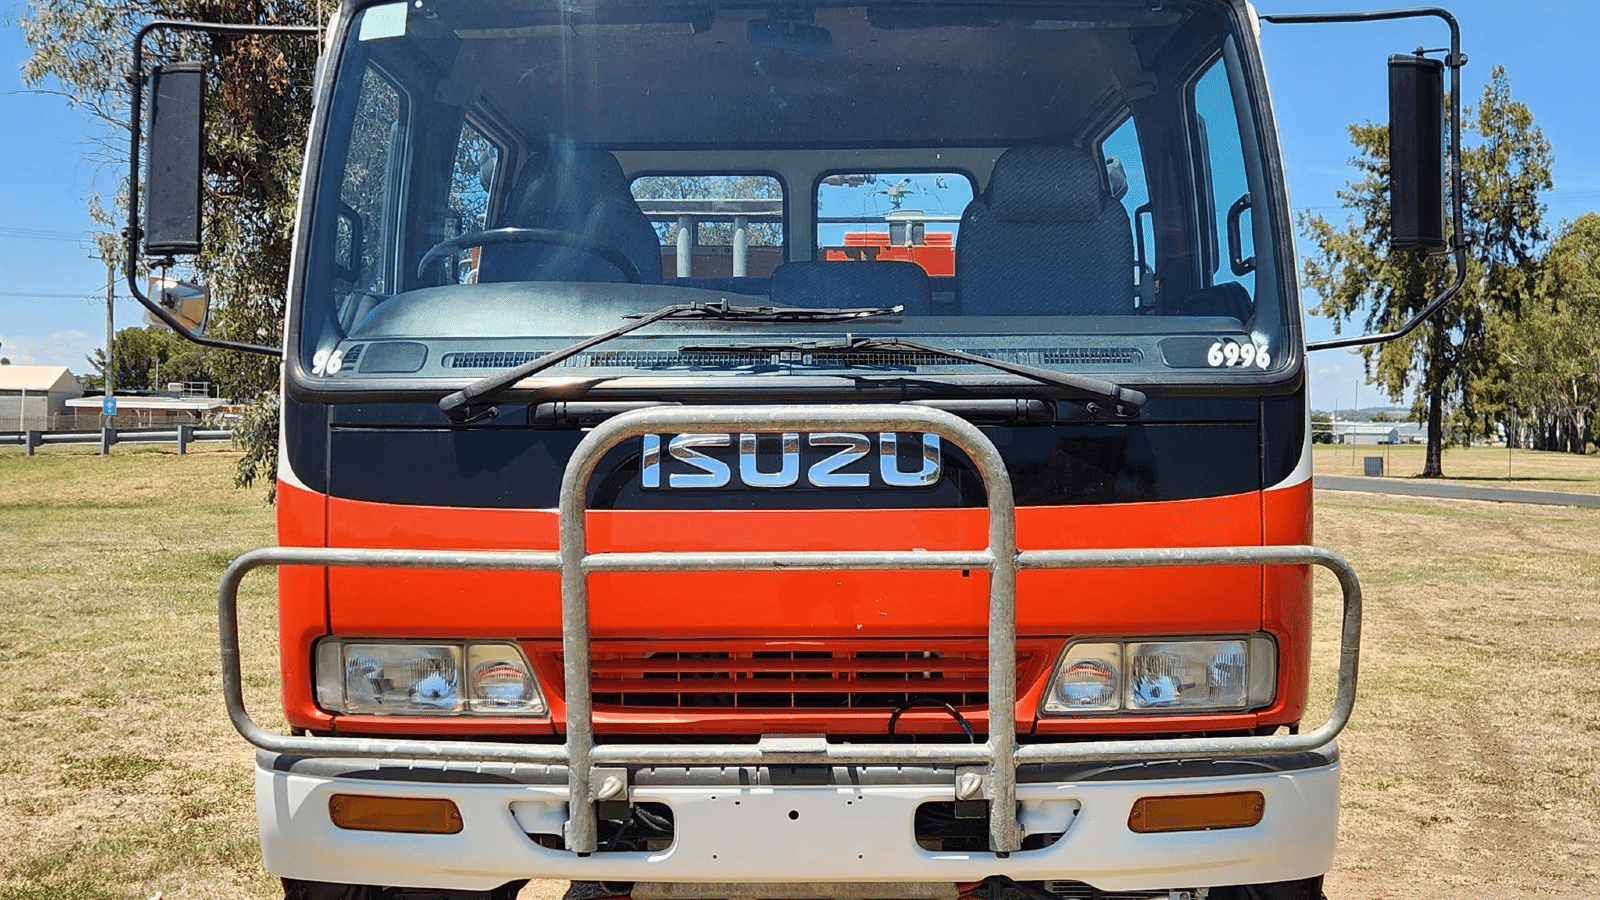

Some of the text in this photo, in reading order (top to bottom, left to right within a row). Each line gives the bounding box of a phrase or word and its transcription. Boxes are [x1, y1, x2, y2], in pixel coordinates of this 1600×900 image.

[312, 350, 343, 375] 96
[1207, 342, 1271, 368] 6996
[642, 433, 941, 488] ISUZU
